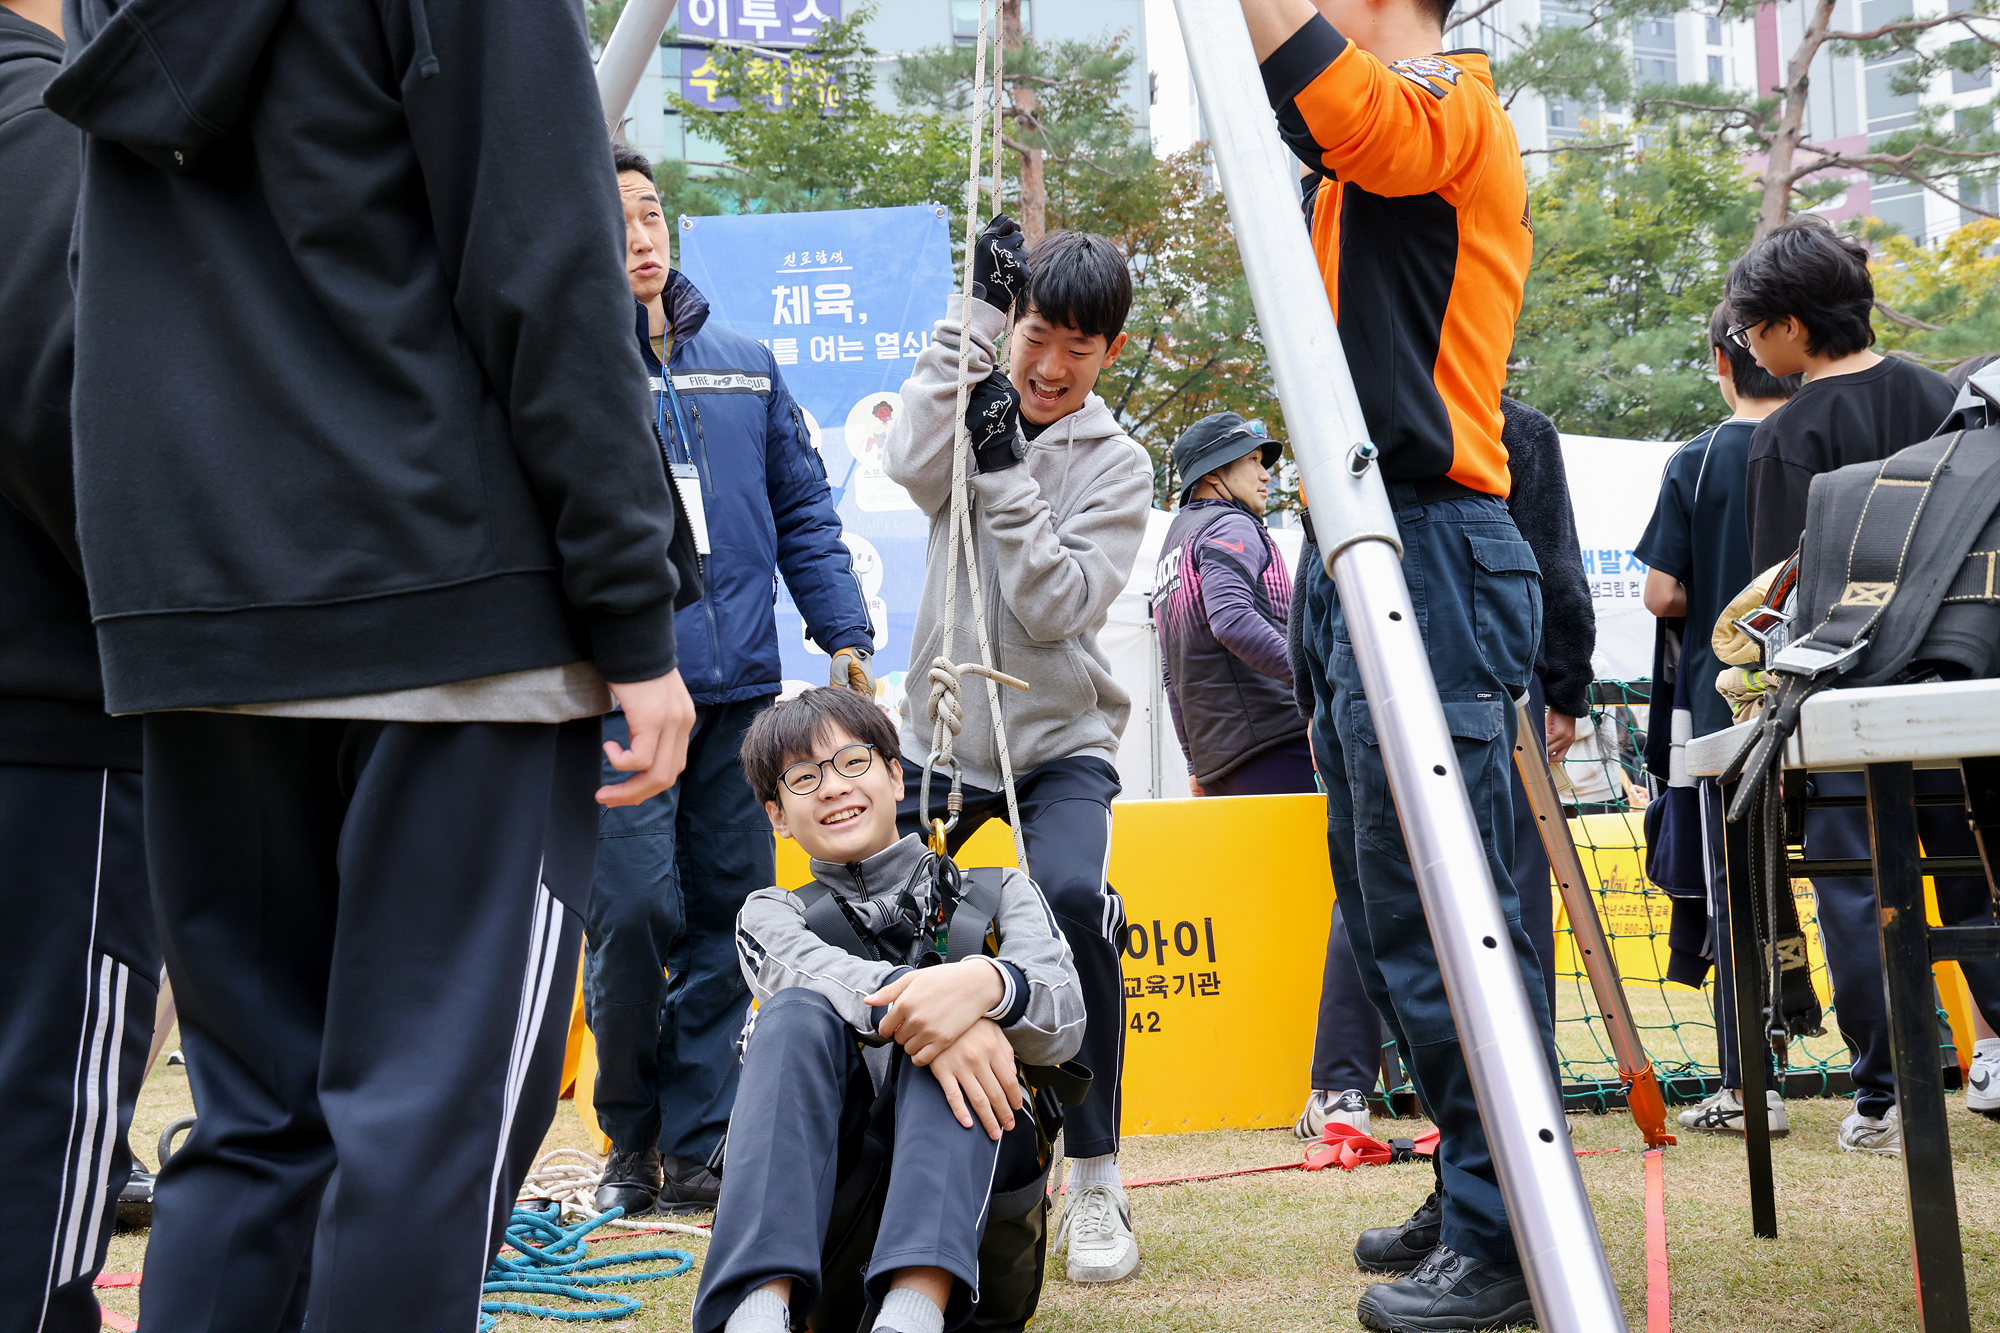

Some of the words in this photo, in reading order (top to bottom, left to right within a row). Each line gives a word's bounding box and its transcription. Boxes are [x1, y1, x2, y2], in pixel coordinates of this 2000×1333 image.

[783, 250, 844, 267] 진로탐색
[771, 284, 868, 325] 체육,
[758, 337, 799, 365] 를
[809, 335, 864, 363] 여는
[689, 376, 710, 387] FIRE
